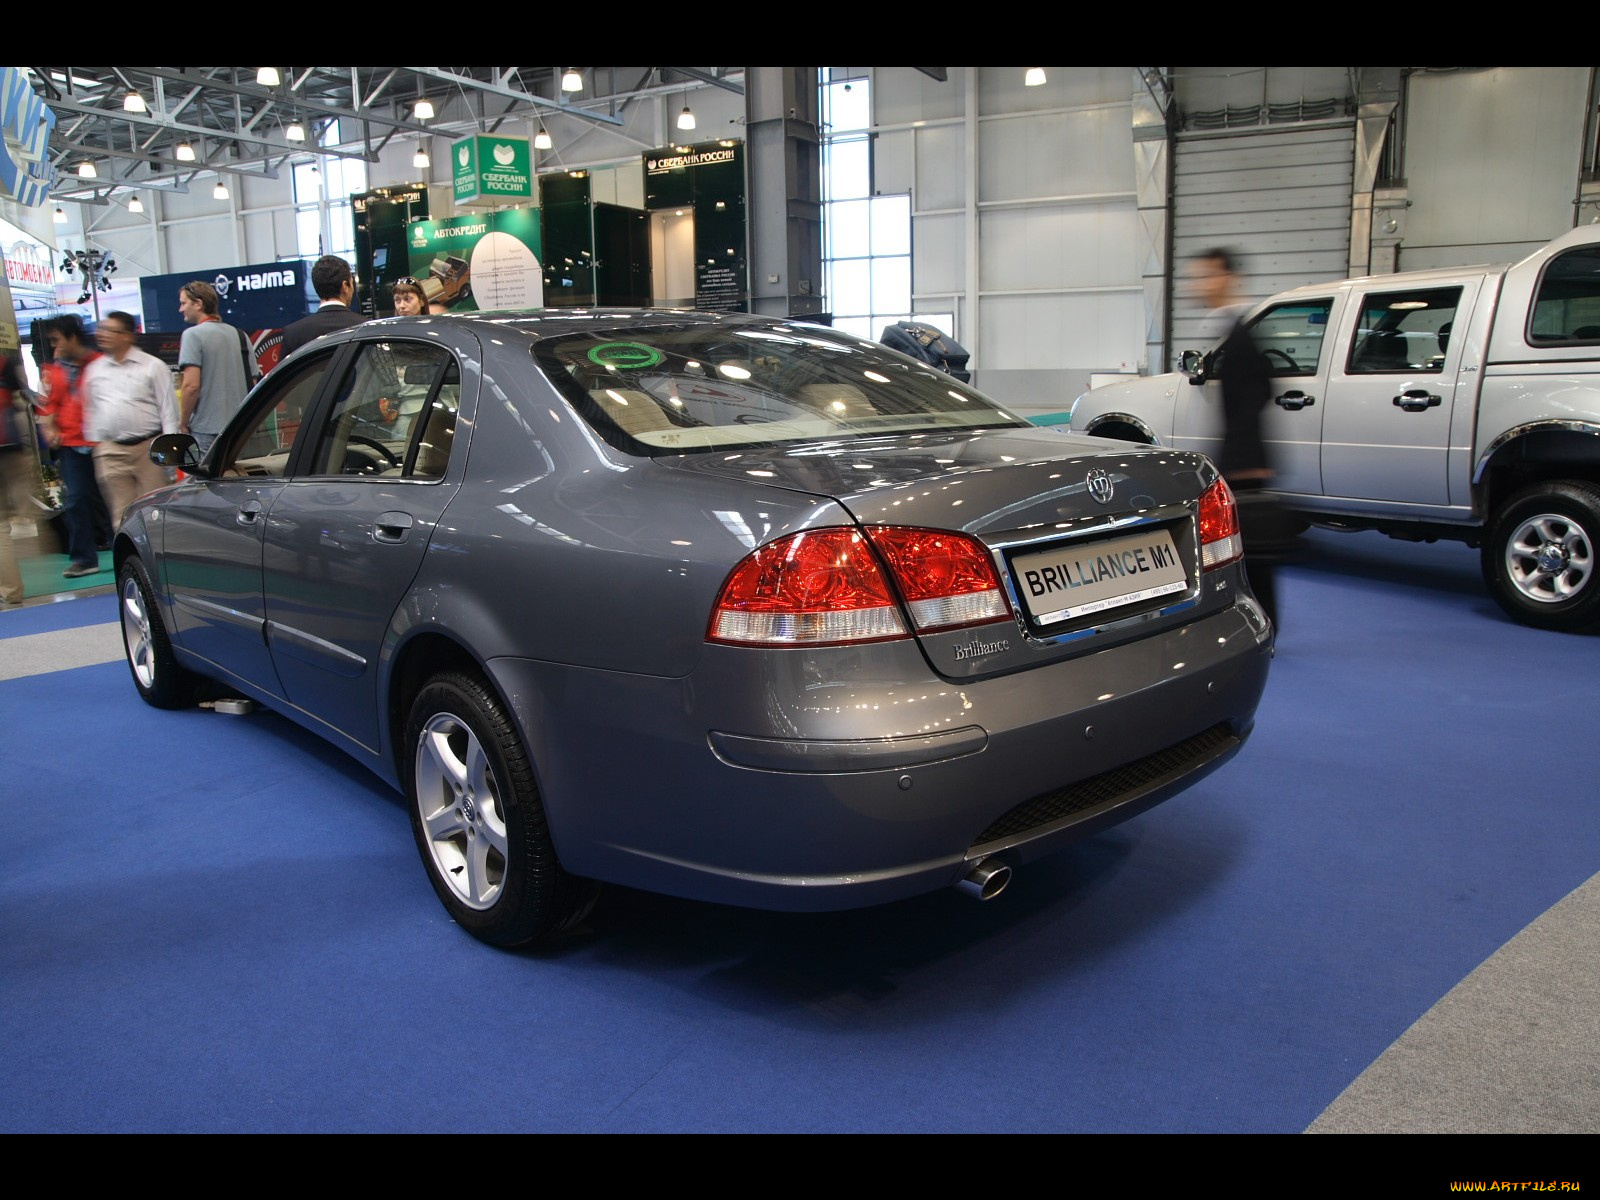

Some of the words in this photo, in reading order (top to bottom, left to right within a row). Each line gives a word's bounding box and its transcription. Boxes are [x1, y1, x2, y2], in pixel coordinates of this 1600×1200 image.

[658, 154, 699, 168] СБЕРБАНК
[700, 150, 734, 163] РОССИИ
[482, 173, 527, 184] СБЕРБАНК
[487, 182, 523, 191] РОССИИ
[433, 224, 486, 239] АВТОКРЕДИТ
[1025, 549, 1149, 597] BRILLIANCE
[1149, 543, 1176, 570] M1
[953, 636, 1010, 661] Brilliance
